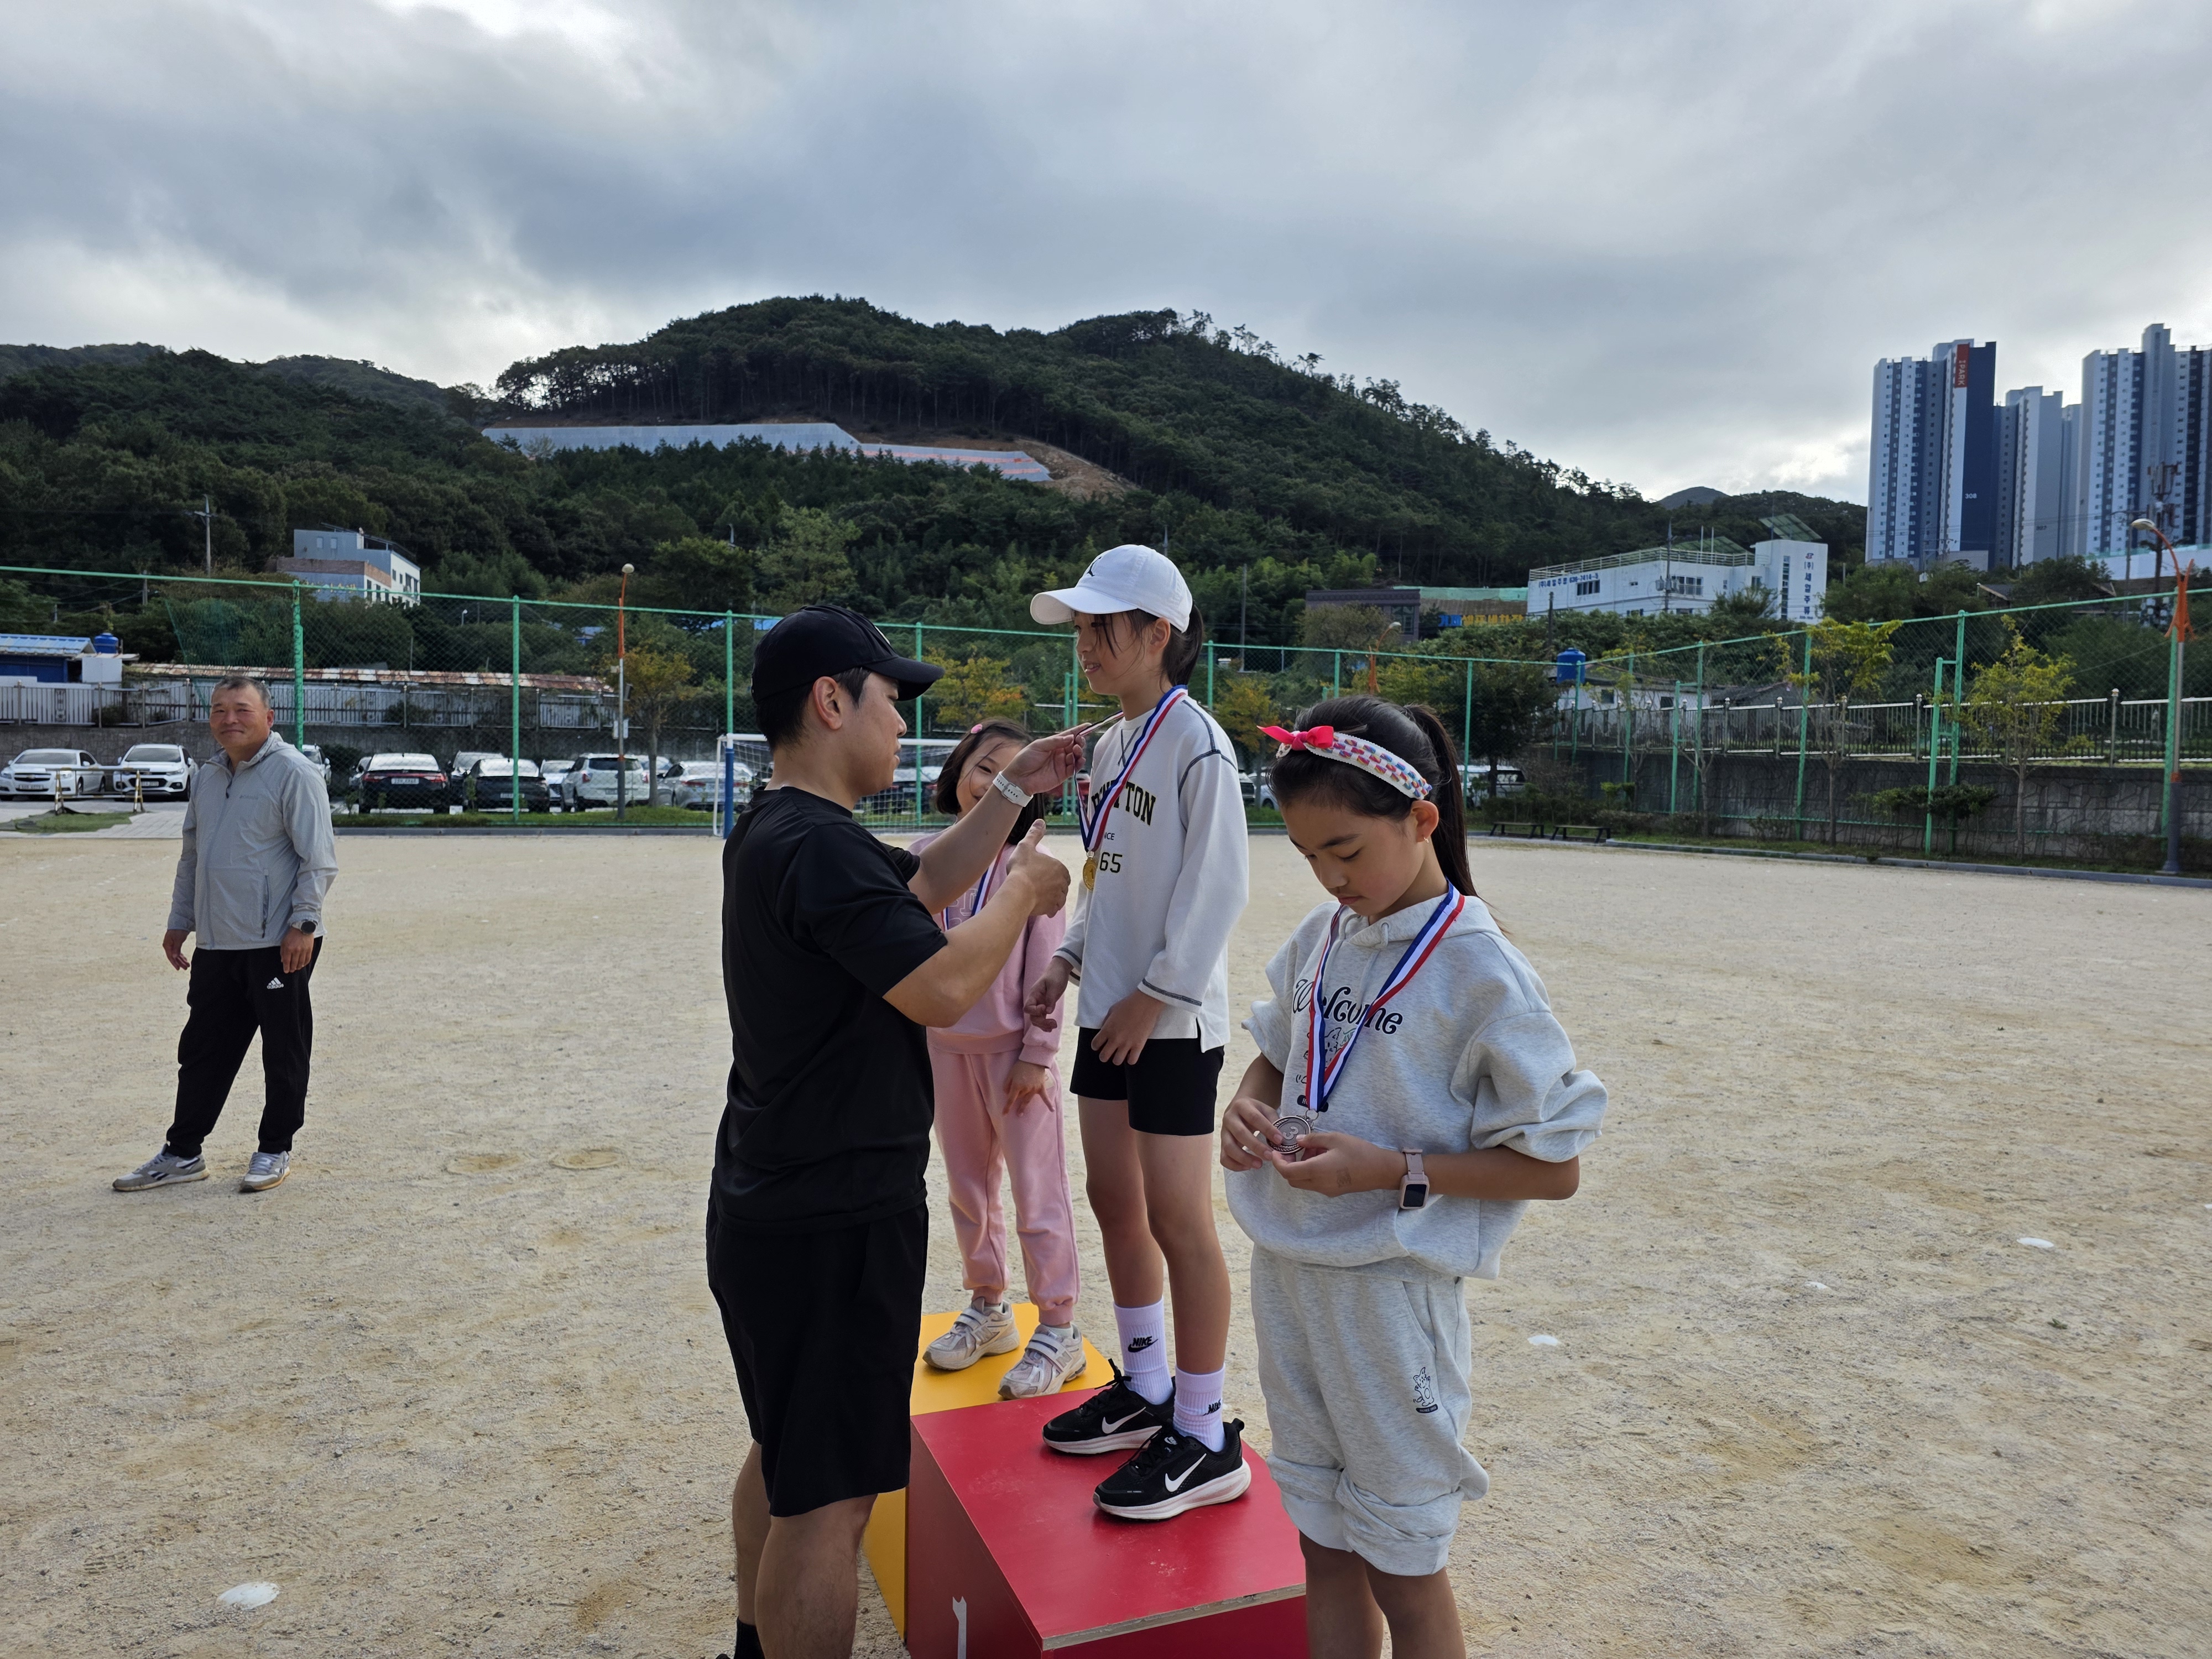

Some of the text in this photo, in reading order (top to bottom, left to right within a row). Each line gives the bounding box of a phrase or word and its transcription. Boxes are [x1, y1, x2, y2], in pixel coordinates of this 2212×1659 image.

[1292, 979, 1403, 1035] Wlcome
[1283, 1126, 1299, 1140] 3
[1132, 1335, 1152, 1347] NIKE
